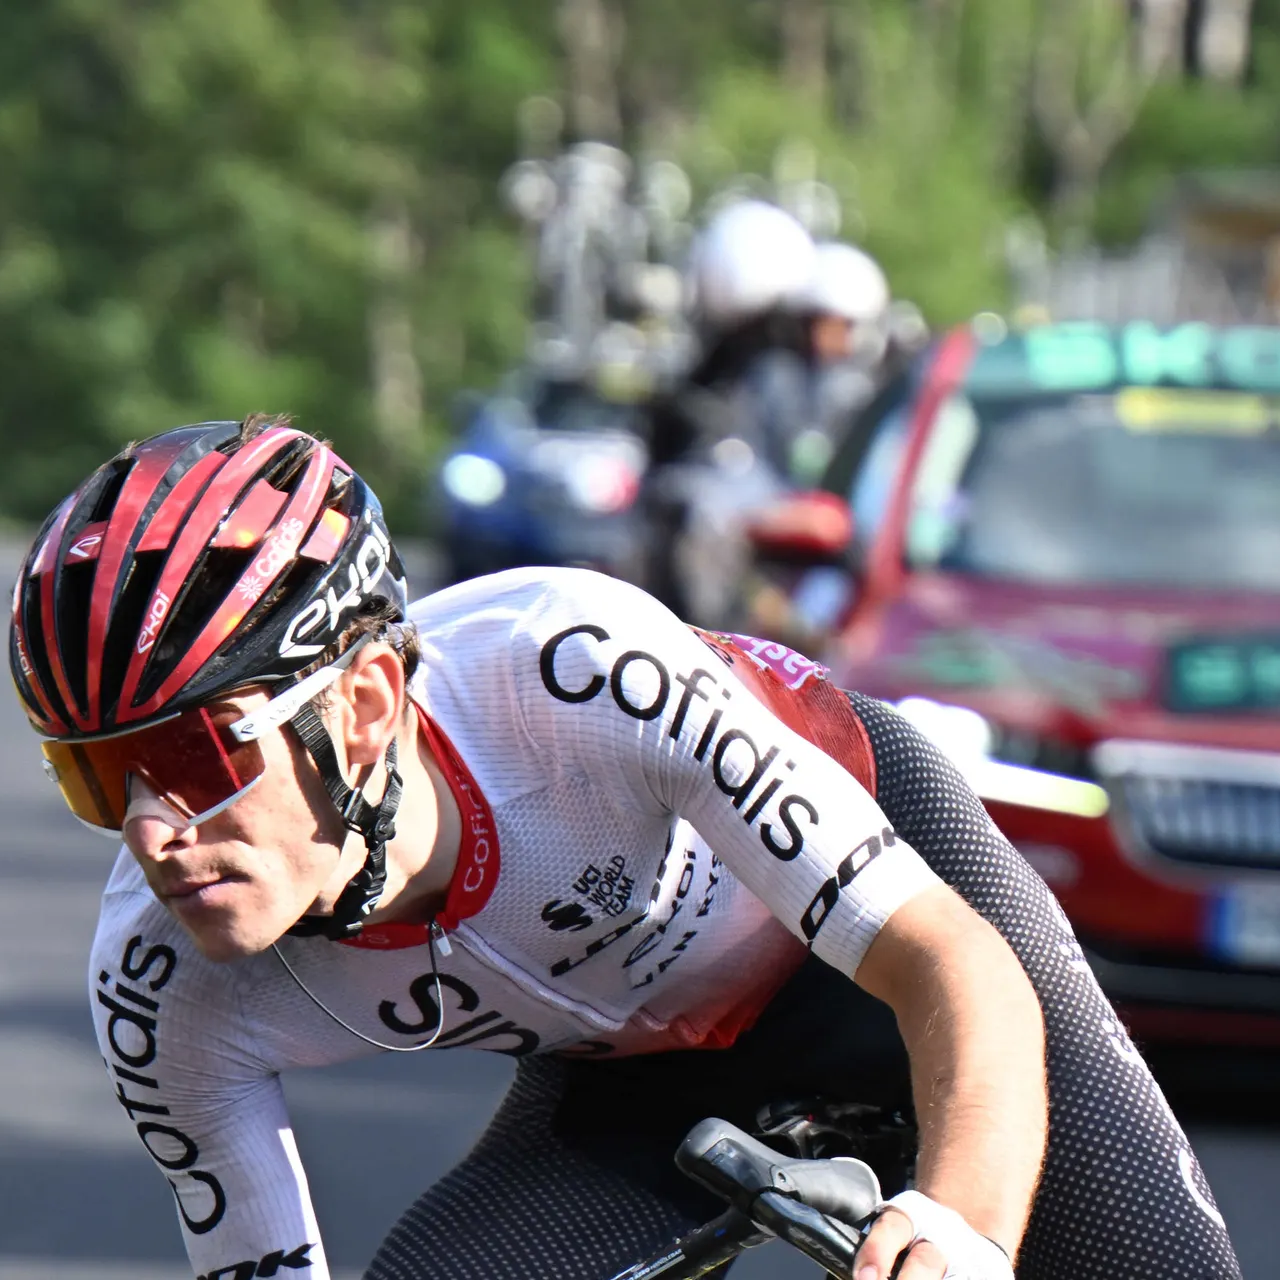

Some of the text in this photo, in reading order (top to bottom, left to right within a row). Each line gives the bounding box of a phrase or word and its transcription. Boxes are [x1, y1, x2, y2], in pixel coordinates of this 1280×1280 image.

[539, 624, 820, 861] Cofidis
[572, 864, 602, 895] UCI
[587, 854, 626, 906] WORLD
[602, 876, 635, 917] TEAM
[97, 934, 227, 1235] Cofidis
